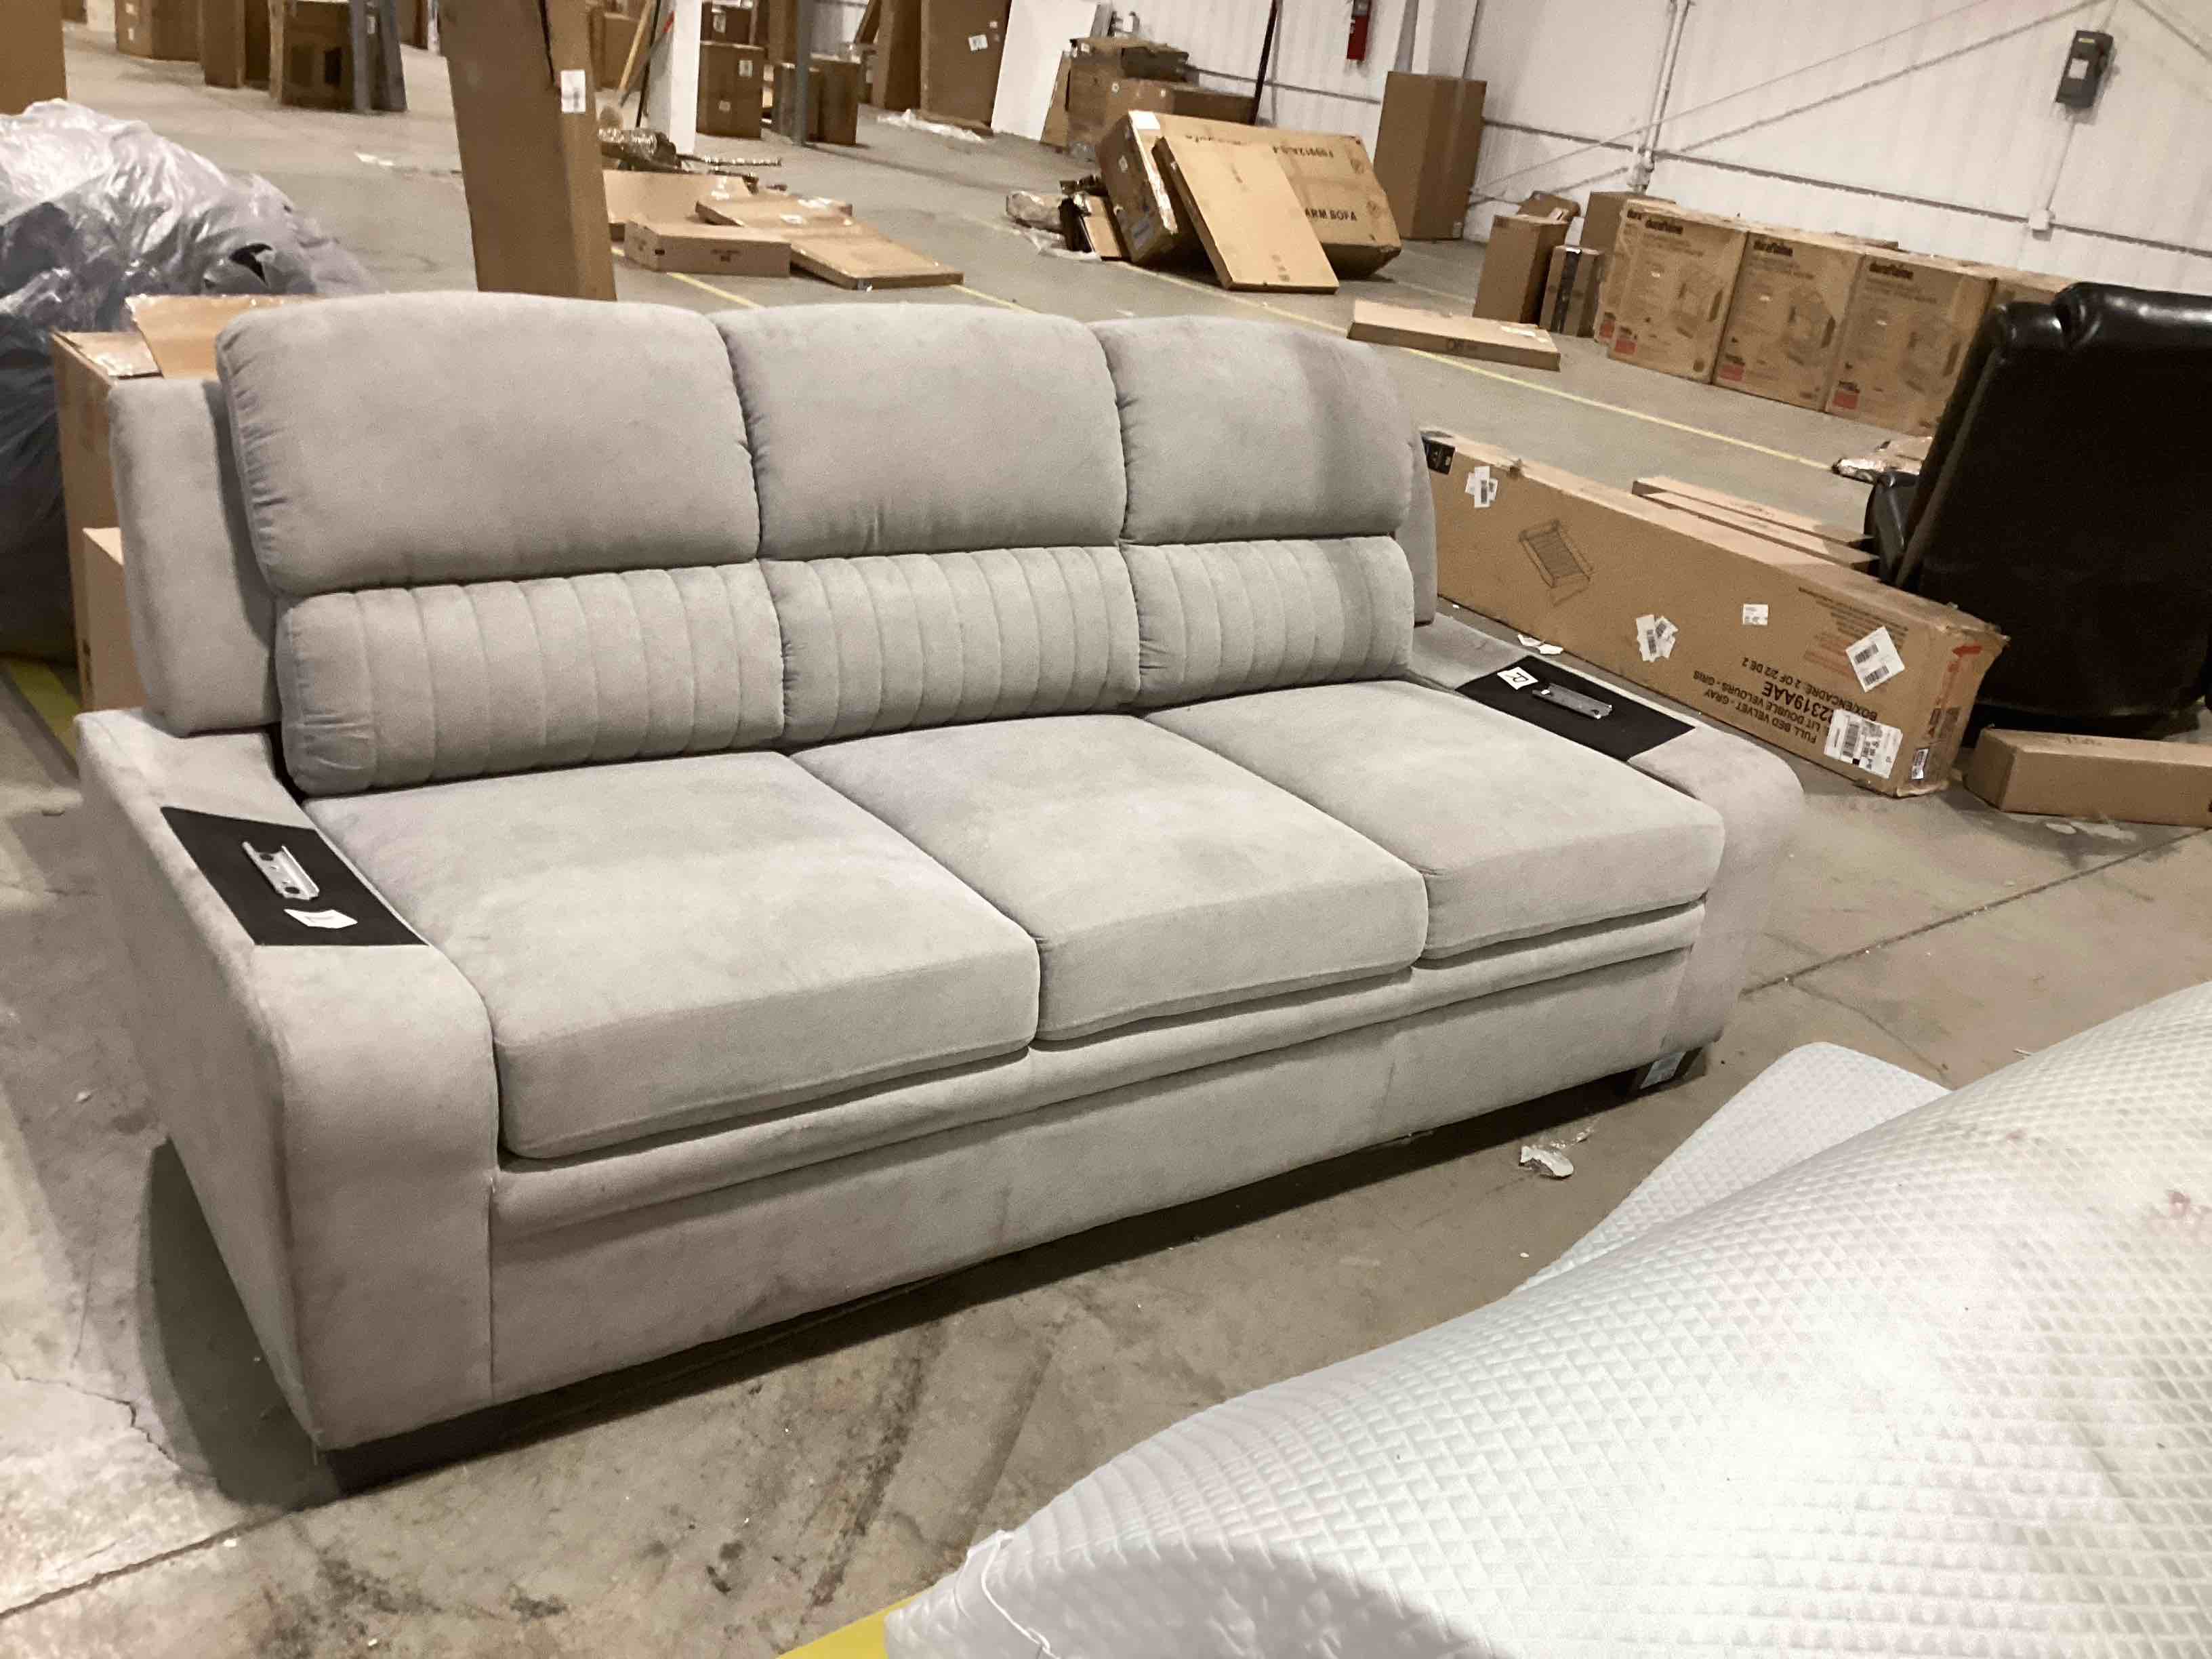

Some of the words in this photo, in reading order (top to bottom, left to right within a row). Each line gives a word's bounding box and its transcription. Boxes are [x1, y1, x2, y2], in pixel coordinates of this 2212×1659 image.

[1704, 689, 1729, 705] GRAY
[1722, 682, 1763, 705] VELOURS
[1735, 702, 1769, 723] VELVET
[1765, 701, 1805, 724] DOUBLE
[1772, 718, 1791, 733] BED
[1805, 719, 1821, 732] LIT
[1795, 726, 1817, 745] FULL
